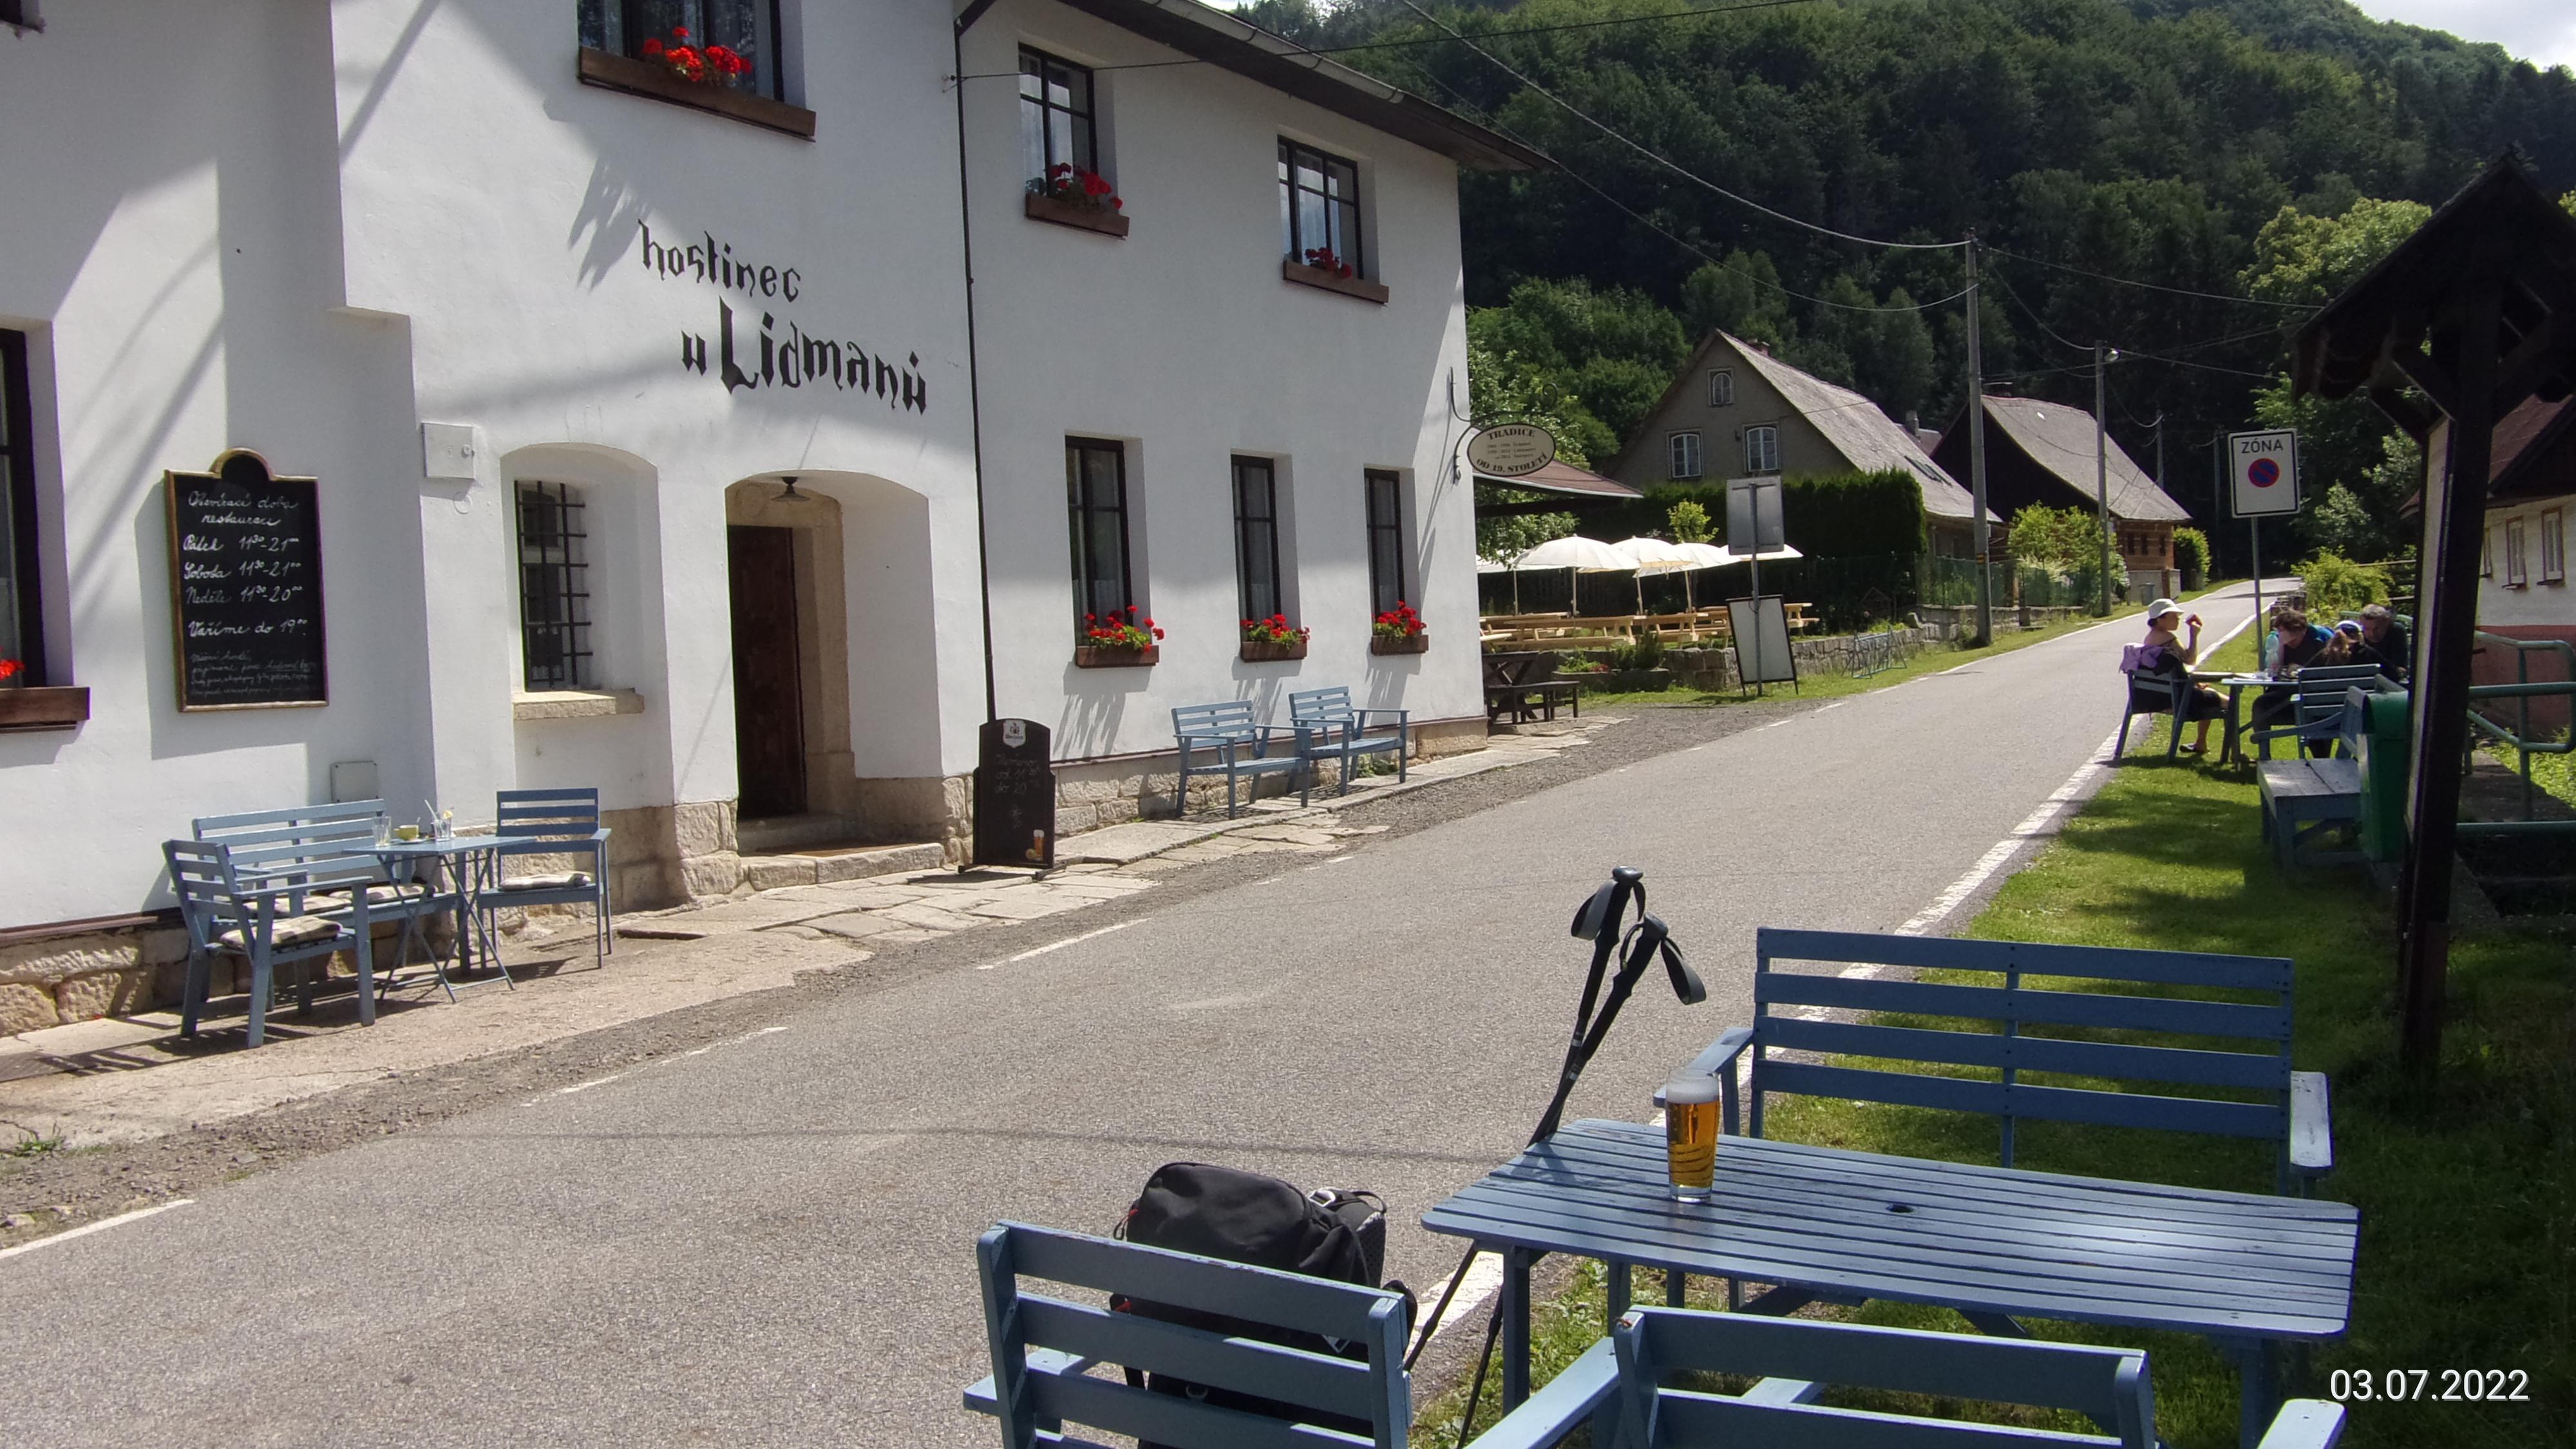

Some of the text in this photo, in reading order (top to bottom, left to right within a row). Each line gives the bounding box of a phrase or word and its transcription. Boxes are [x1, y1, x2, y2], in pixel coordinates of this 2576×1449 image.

[638, 218, 800, 303] hostinec
[681, 295, 926, 415] u Lidmanů
[1487, 428, 1535, 440] TRADICE
[2241, 438, 2284, 454] ZÓNA
[1476, 459, 1490, 469] OD
[1493, 464, 1505, 473] 19.
[1508, 451, 1548, 472] STOLETÍ
[258, 495, 298, 509] doba
[188, 620, 251, 638] Vaříme
[255, 621, 274, 634] do
